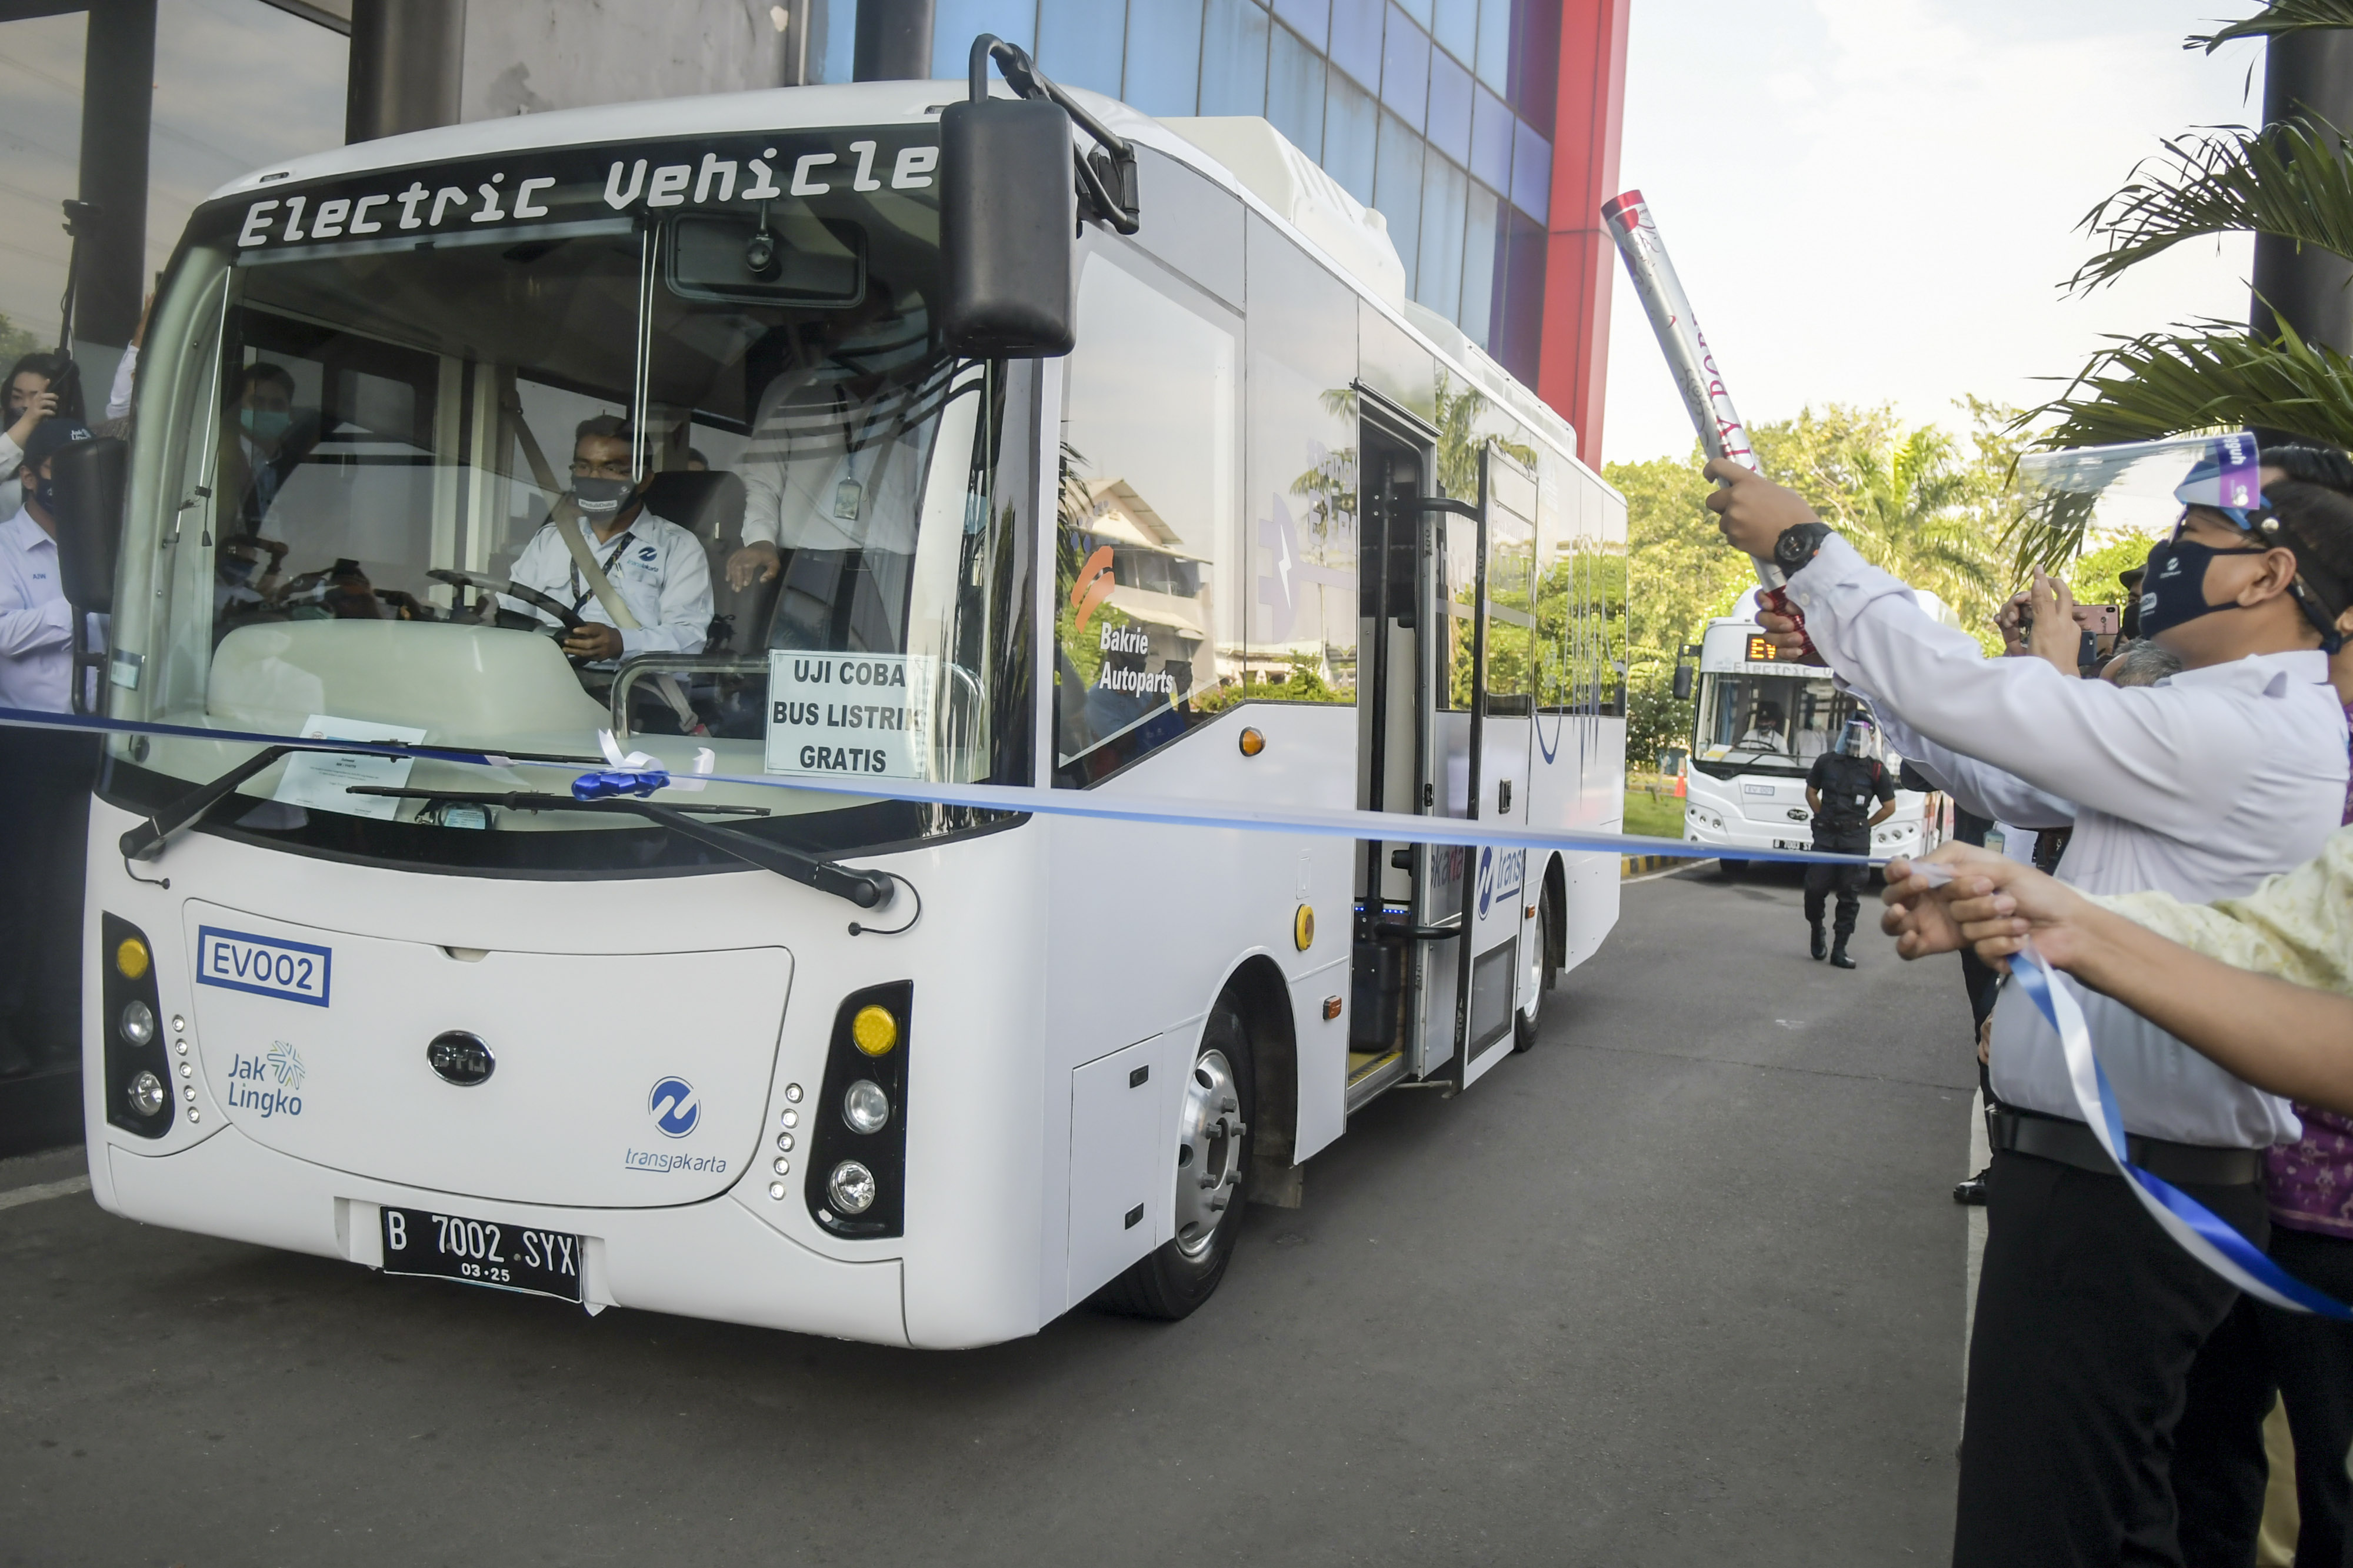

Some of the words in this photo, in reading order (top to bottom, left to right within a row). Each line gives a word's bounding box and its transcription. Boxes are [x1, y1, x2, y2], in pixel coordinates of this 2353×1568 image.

[237, 172, 556, 247] Electric
[604, 140, 939, 210] Vehicle
[1099, 622, 1148, 655] Bakrie
[794, 659, 831, 683] UJI
[839, 661, 906, 688] COBA
[1098, 661, 1173, 698] Autoparts
[773, 701, 819, 726] BUS
[799, 745, 886, 773] GRATIS
[214, 942, 313, 990] EV002
[228, 1053, 266, 1082] Jak
[228, 1081, 302, 1118] Lingko
[625, 1147, 726, 1173] transjakarta
[388, 1210, 407, 1250] B
[432, 1215, 505, 1263] 7002
[523, 1230, 575, 1276] SYX
